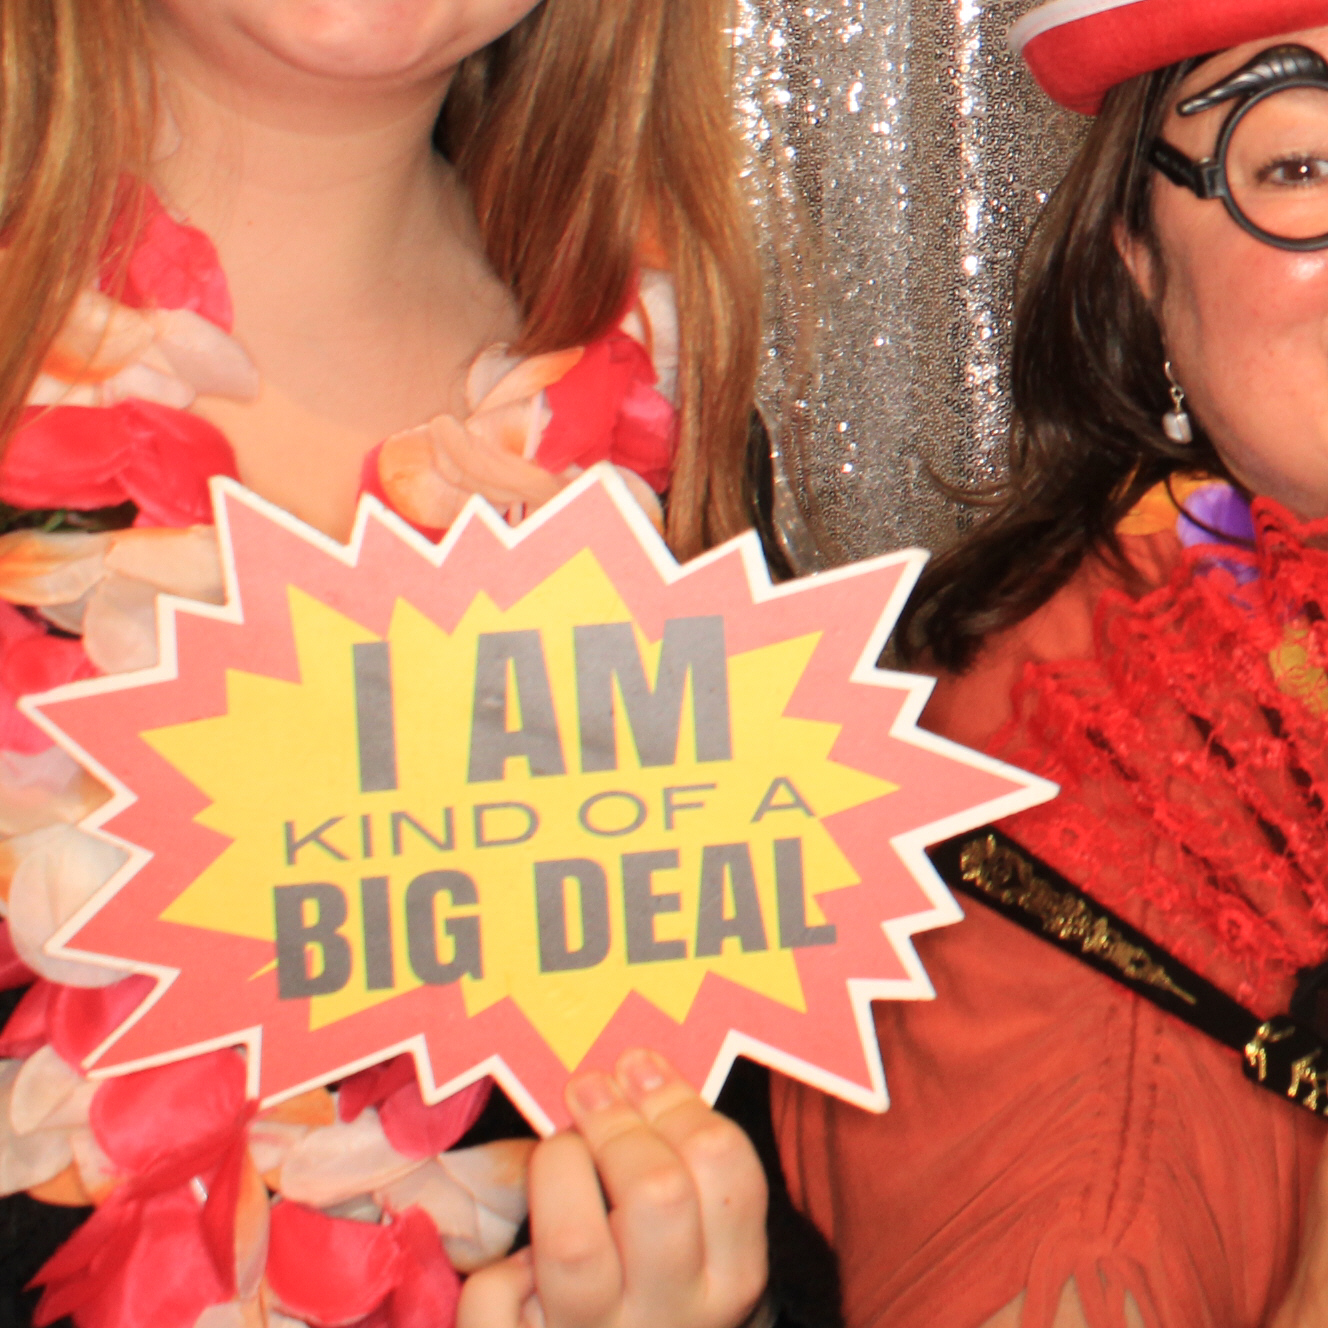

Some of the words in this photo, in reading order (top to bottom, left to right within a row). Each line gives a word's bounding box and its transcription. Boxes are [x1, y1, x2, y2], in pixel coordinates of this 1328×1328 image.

[351, 642, 398, 793] I
[467, 615, 733, 783] AM
[283, 800, 540, 866] KIND
[578, 782, 718, 837] OF
[750, 776, 819, 824] A
[272, 868, 484, 1001] BIG
[533, 837, 838, 974] DEAL
